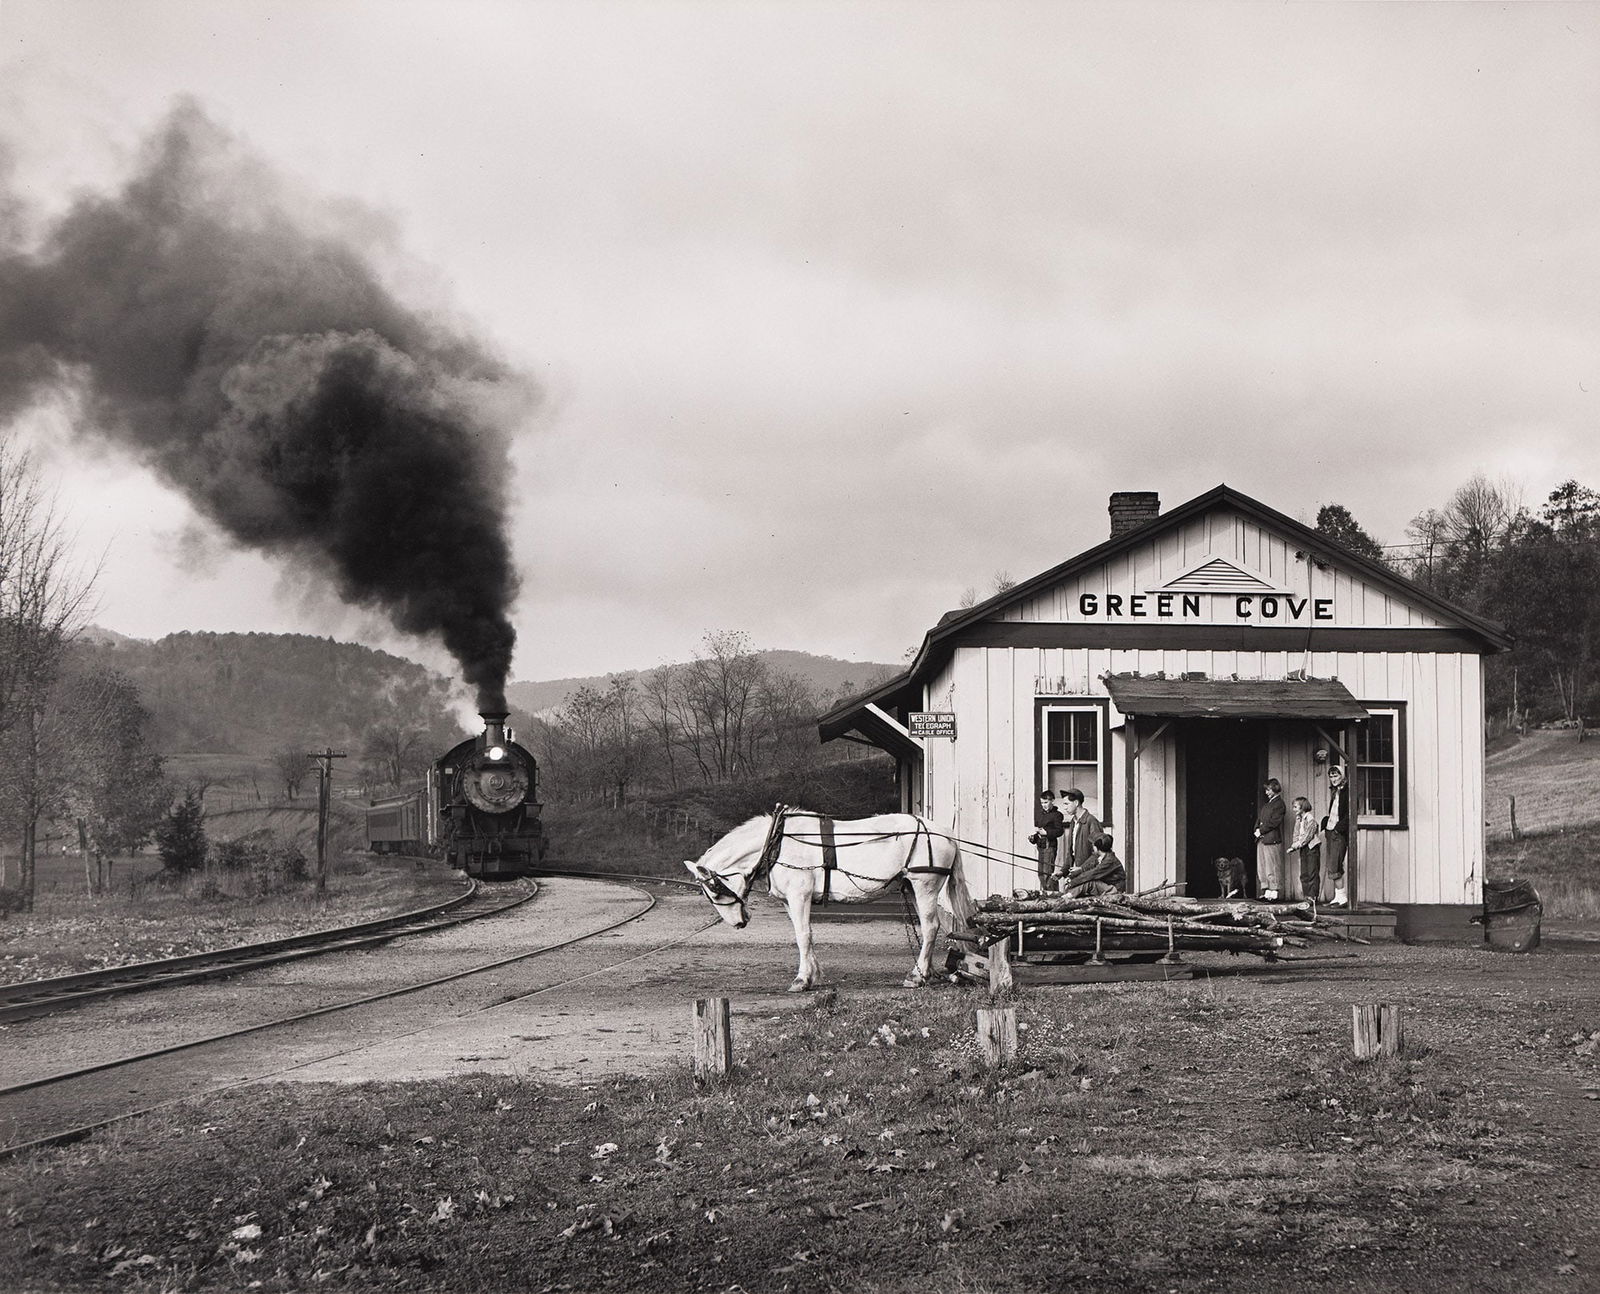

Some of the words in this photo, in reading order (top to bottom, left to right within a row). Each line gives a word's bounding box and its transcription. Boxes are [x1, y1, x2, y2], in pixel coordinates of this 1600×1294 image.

[1079, 593, 1200, 617] GREEN
[1236, 597, 1333, 620] COVE
[911, 714, 936, 722] WESTERN
[937, 714, 954, 722] UNION
